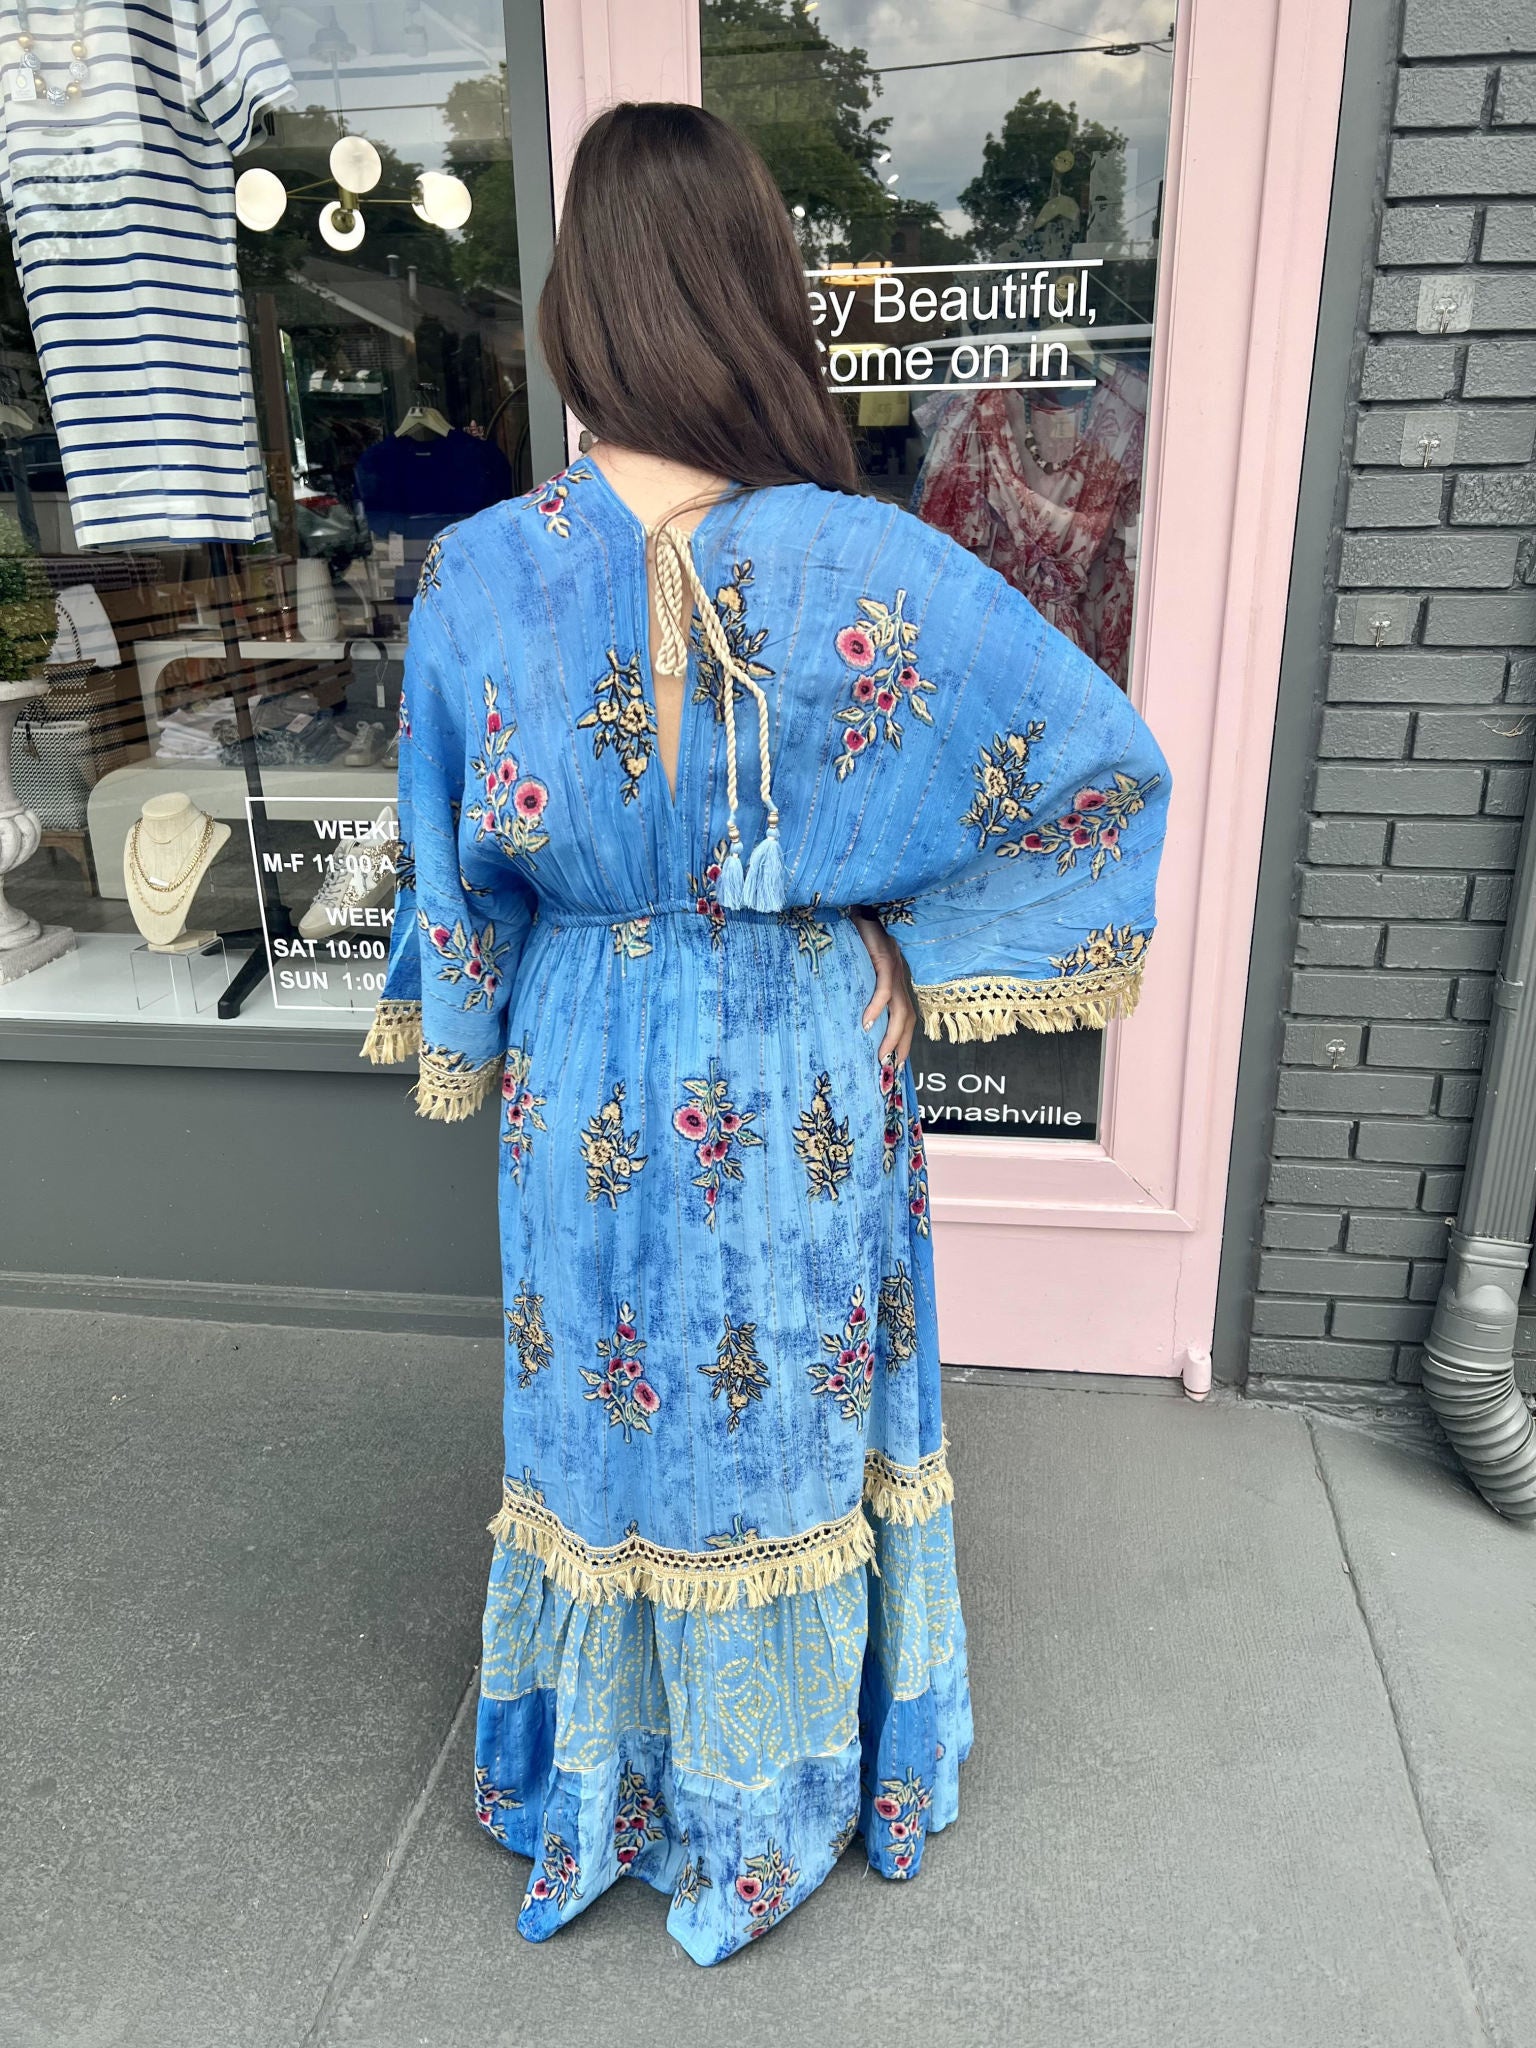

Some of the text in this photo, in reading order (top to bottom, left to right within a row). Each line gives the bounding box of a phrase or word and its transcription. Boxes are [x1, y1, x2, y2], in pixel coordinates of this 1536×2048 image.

[874, 270, 1096, 325] Beautiful,
[951, 344, 1009, 380] on
[1029, 335, 1068, 377] in
[263, 853, 304, 873] M-F
[312, 854, 372, 873] 11:00
[325, 908, 395, 927] WEEK
[273, 939, 385, 960] SAT 10:00
[279, 971, 386, 991] SUN 1:00
[958, 1073, 1006, 1094] ON
